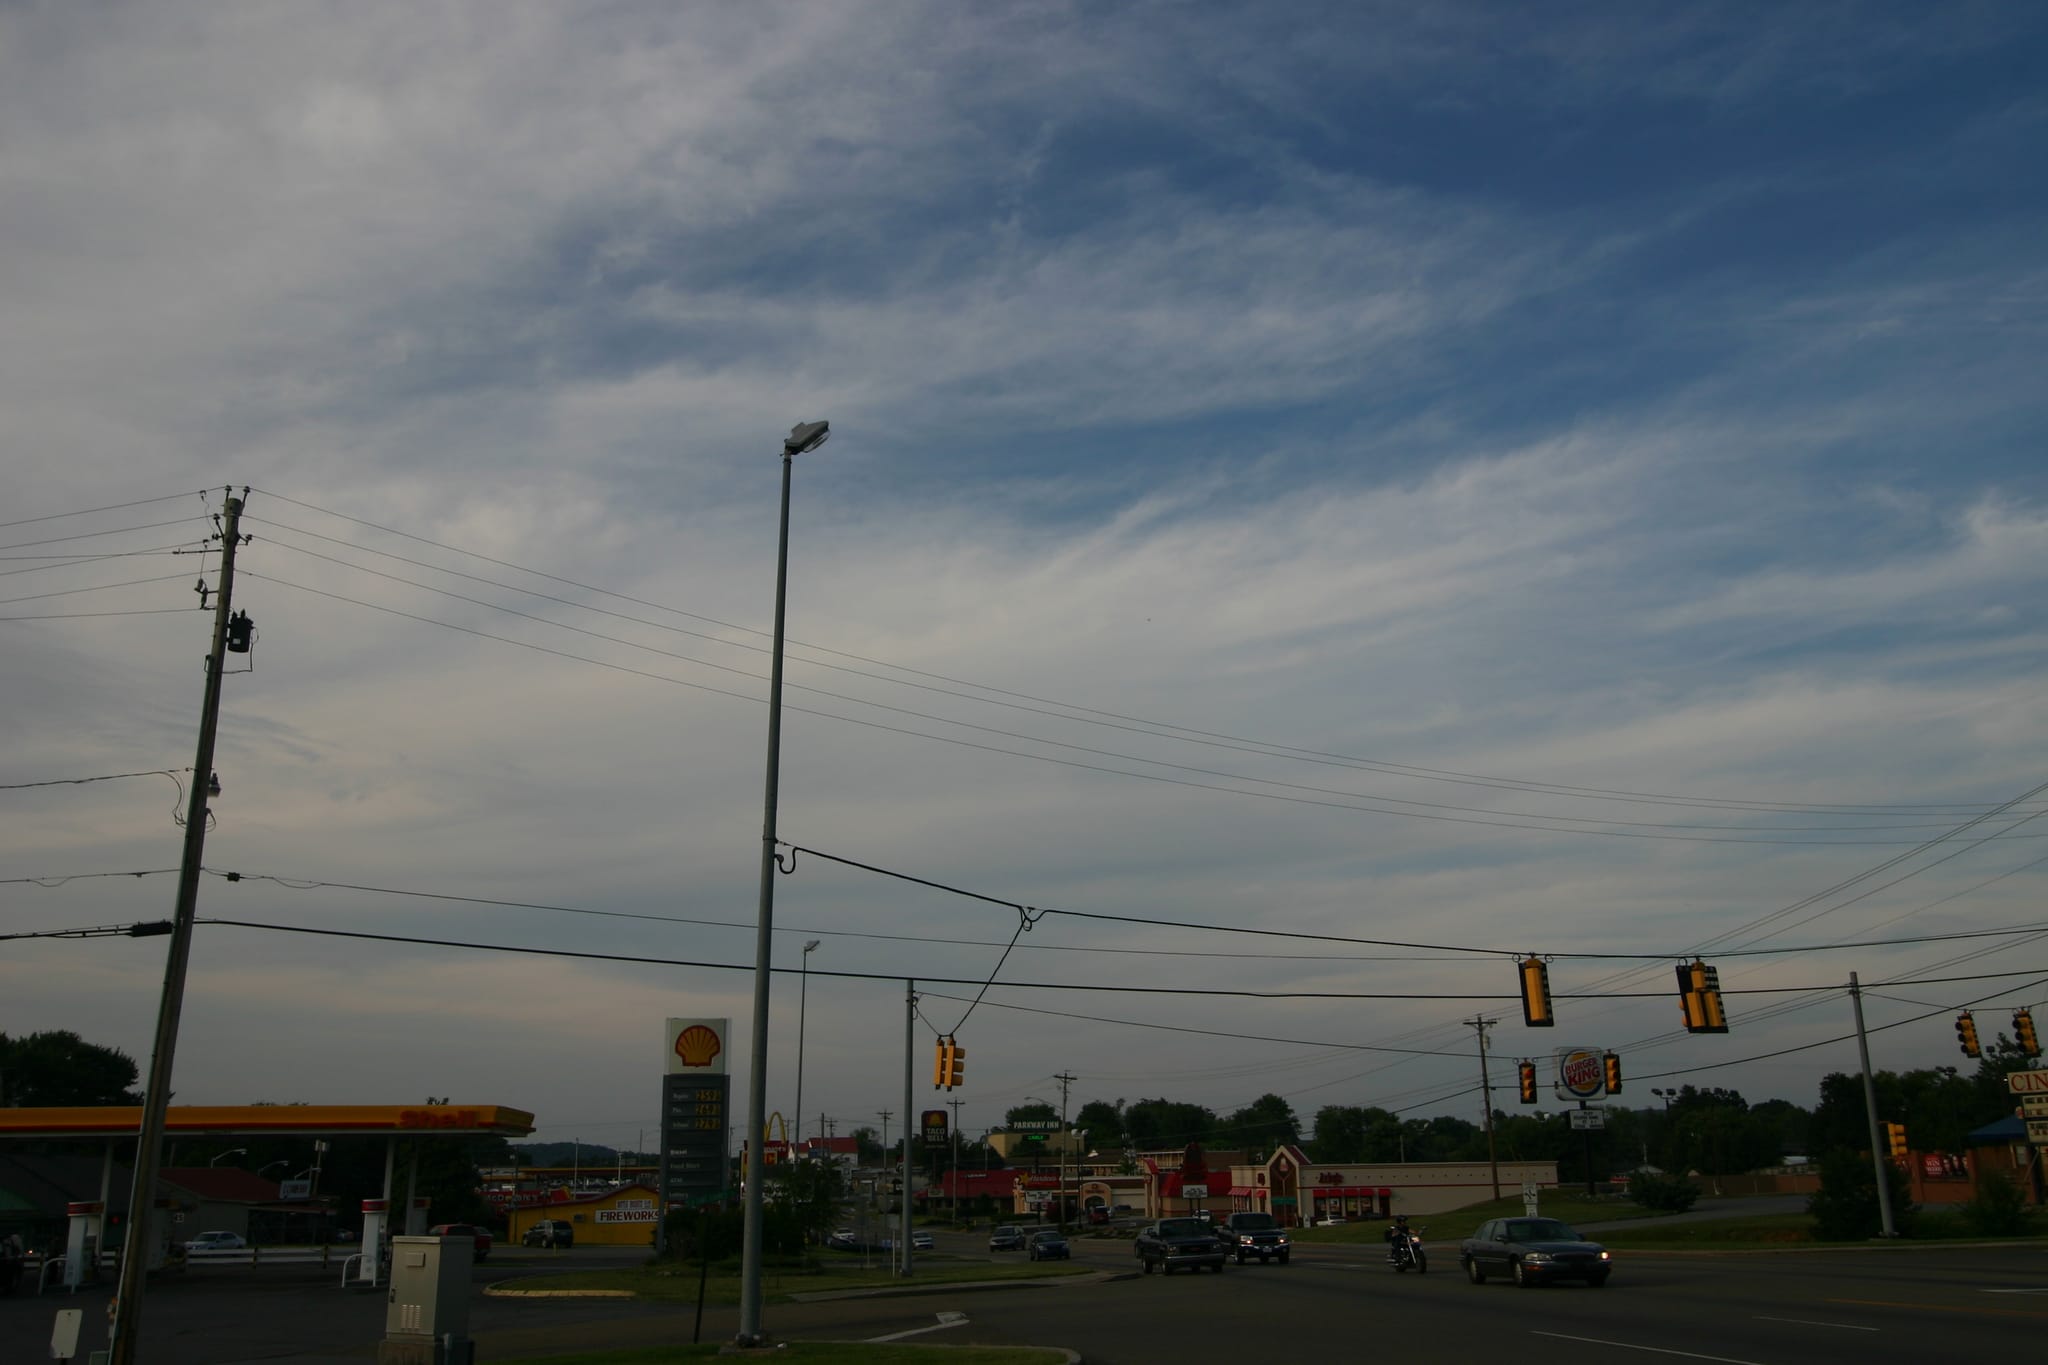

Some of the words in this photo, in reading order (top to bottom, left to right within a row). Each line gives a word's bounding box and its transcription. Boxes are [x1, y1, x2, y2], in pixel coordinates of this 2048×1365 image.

[1565, 1057, 1596, 1076] BURGER
[1568, 1066, 1600, 1087] KING
[926, 1127, 945, 1135] TACO
[1013, 1121, 1045, 1129] PARKWAY
[1047, 1121, 1059, 1129] INN
